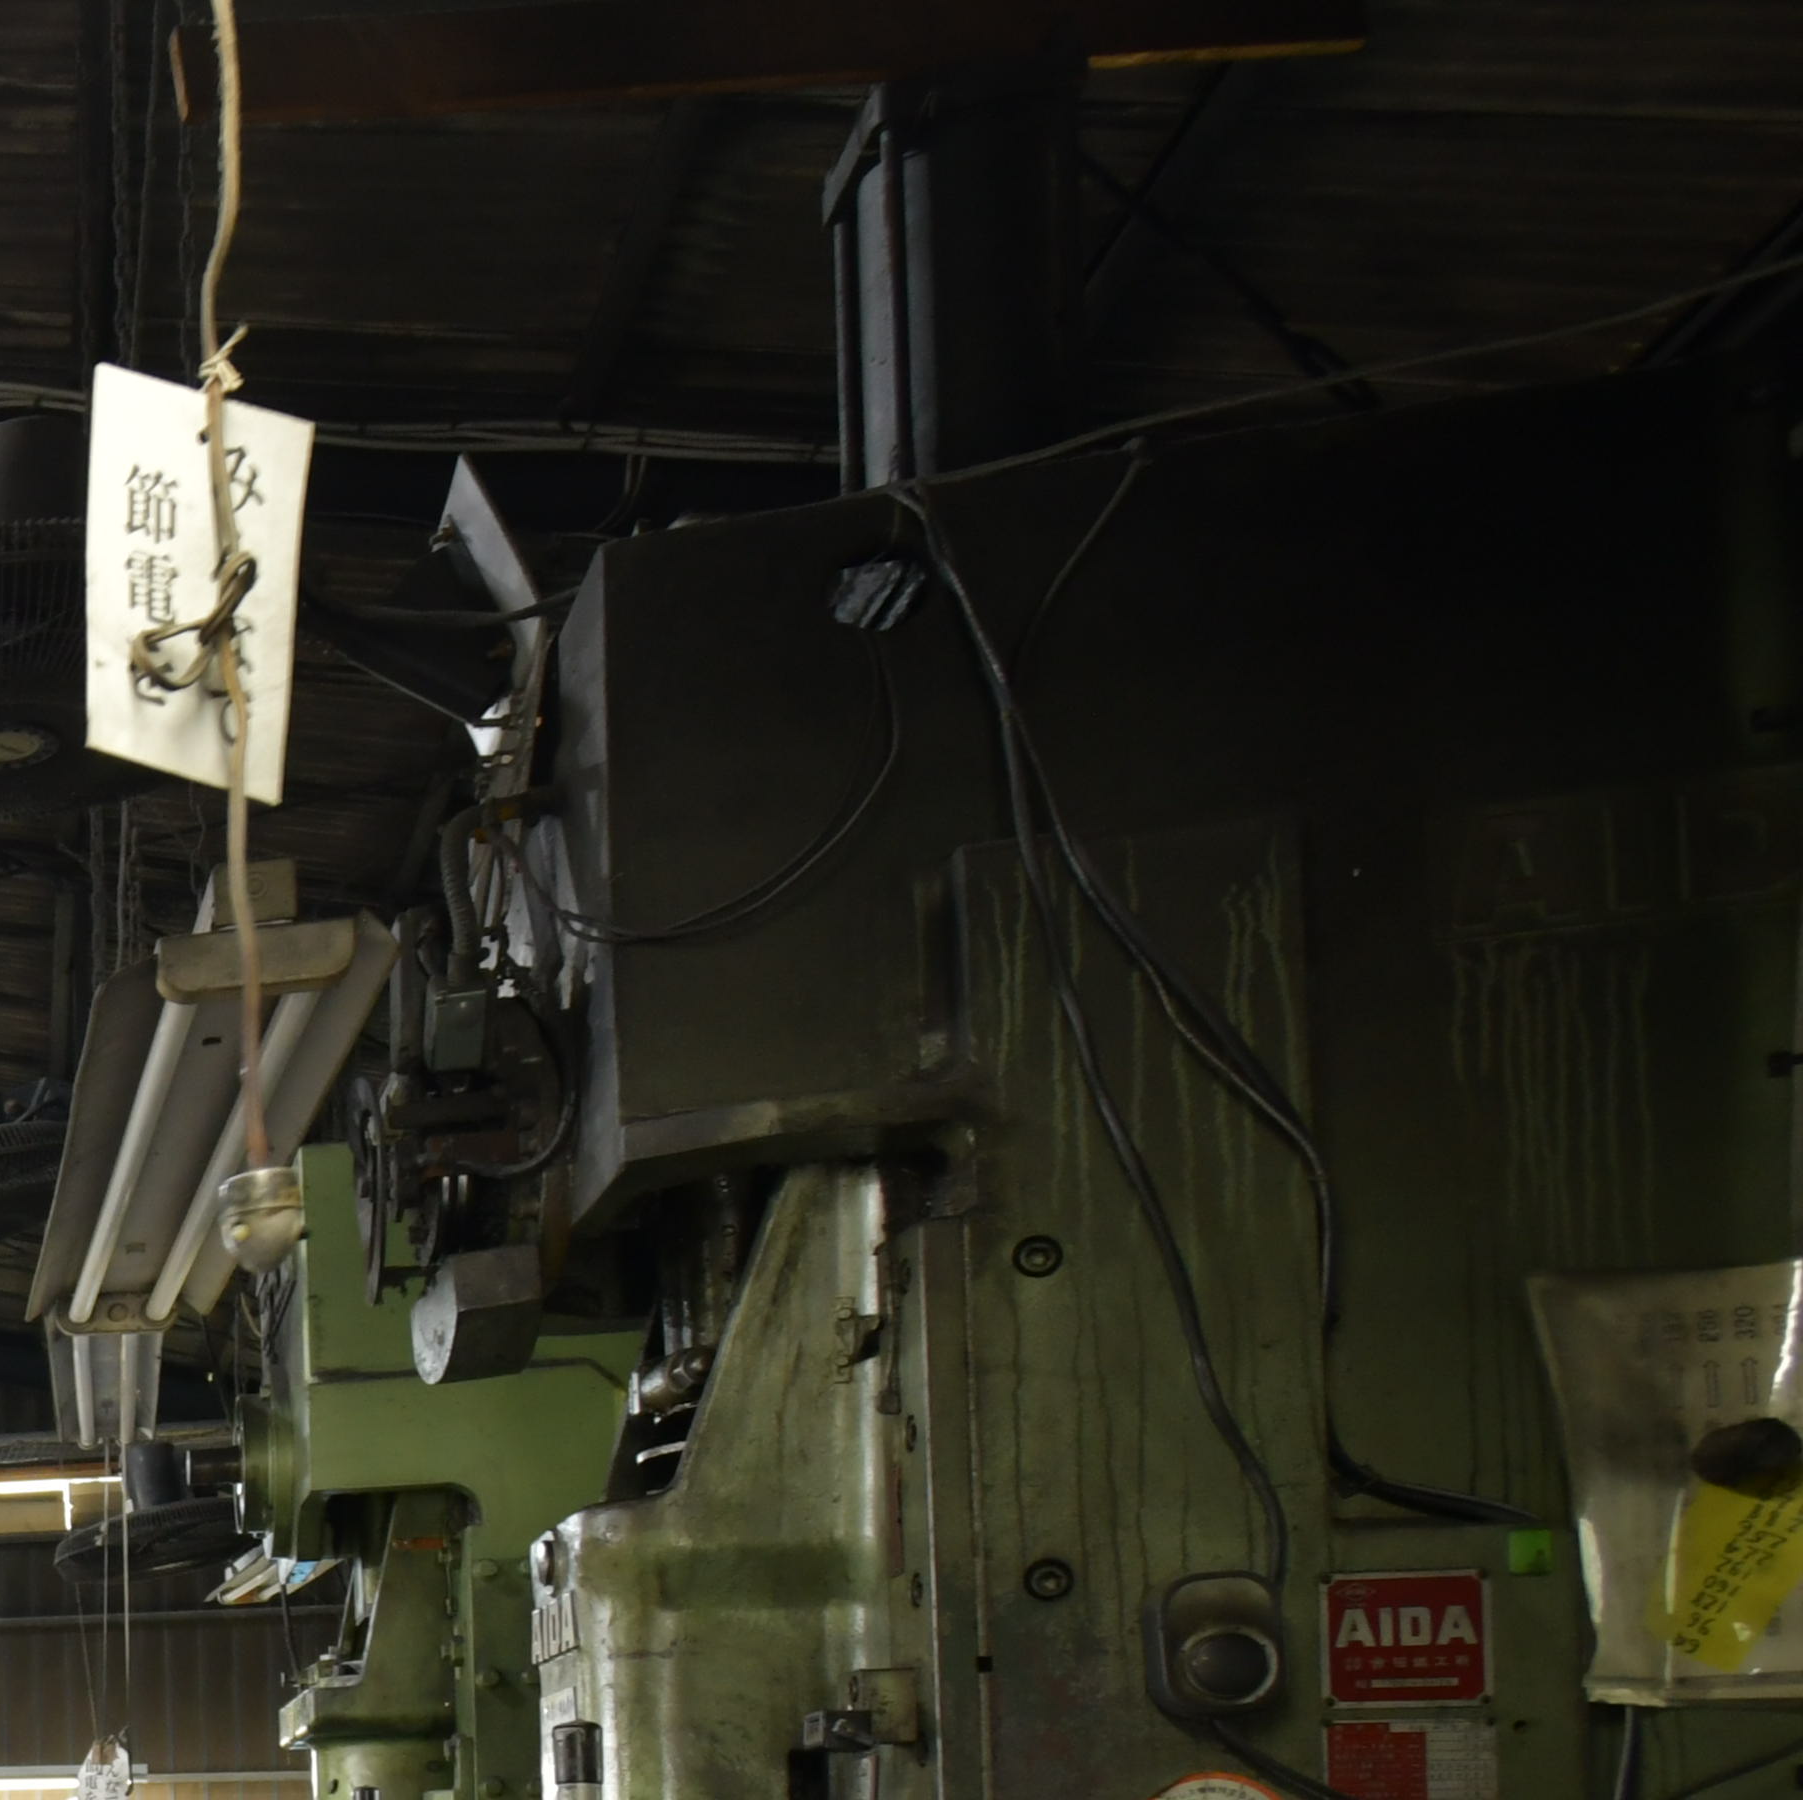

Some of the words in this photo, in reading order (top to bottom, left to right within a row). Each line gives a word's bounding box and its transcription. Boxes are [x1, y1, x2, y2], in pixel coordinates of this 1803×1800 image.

[1734, 1305, 1757, 1340] 320
[531, 1592, 579, 1666] AIDA
[1334, 1604, 1479, 1648] AIDA
